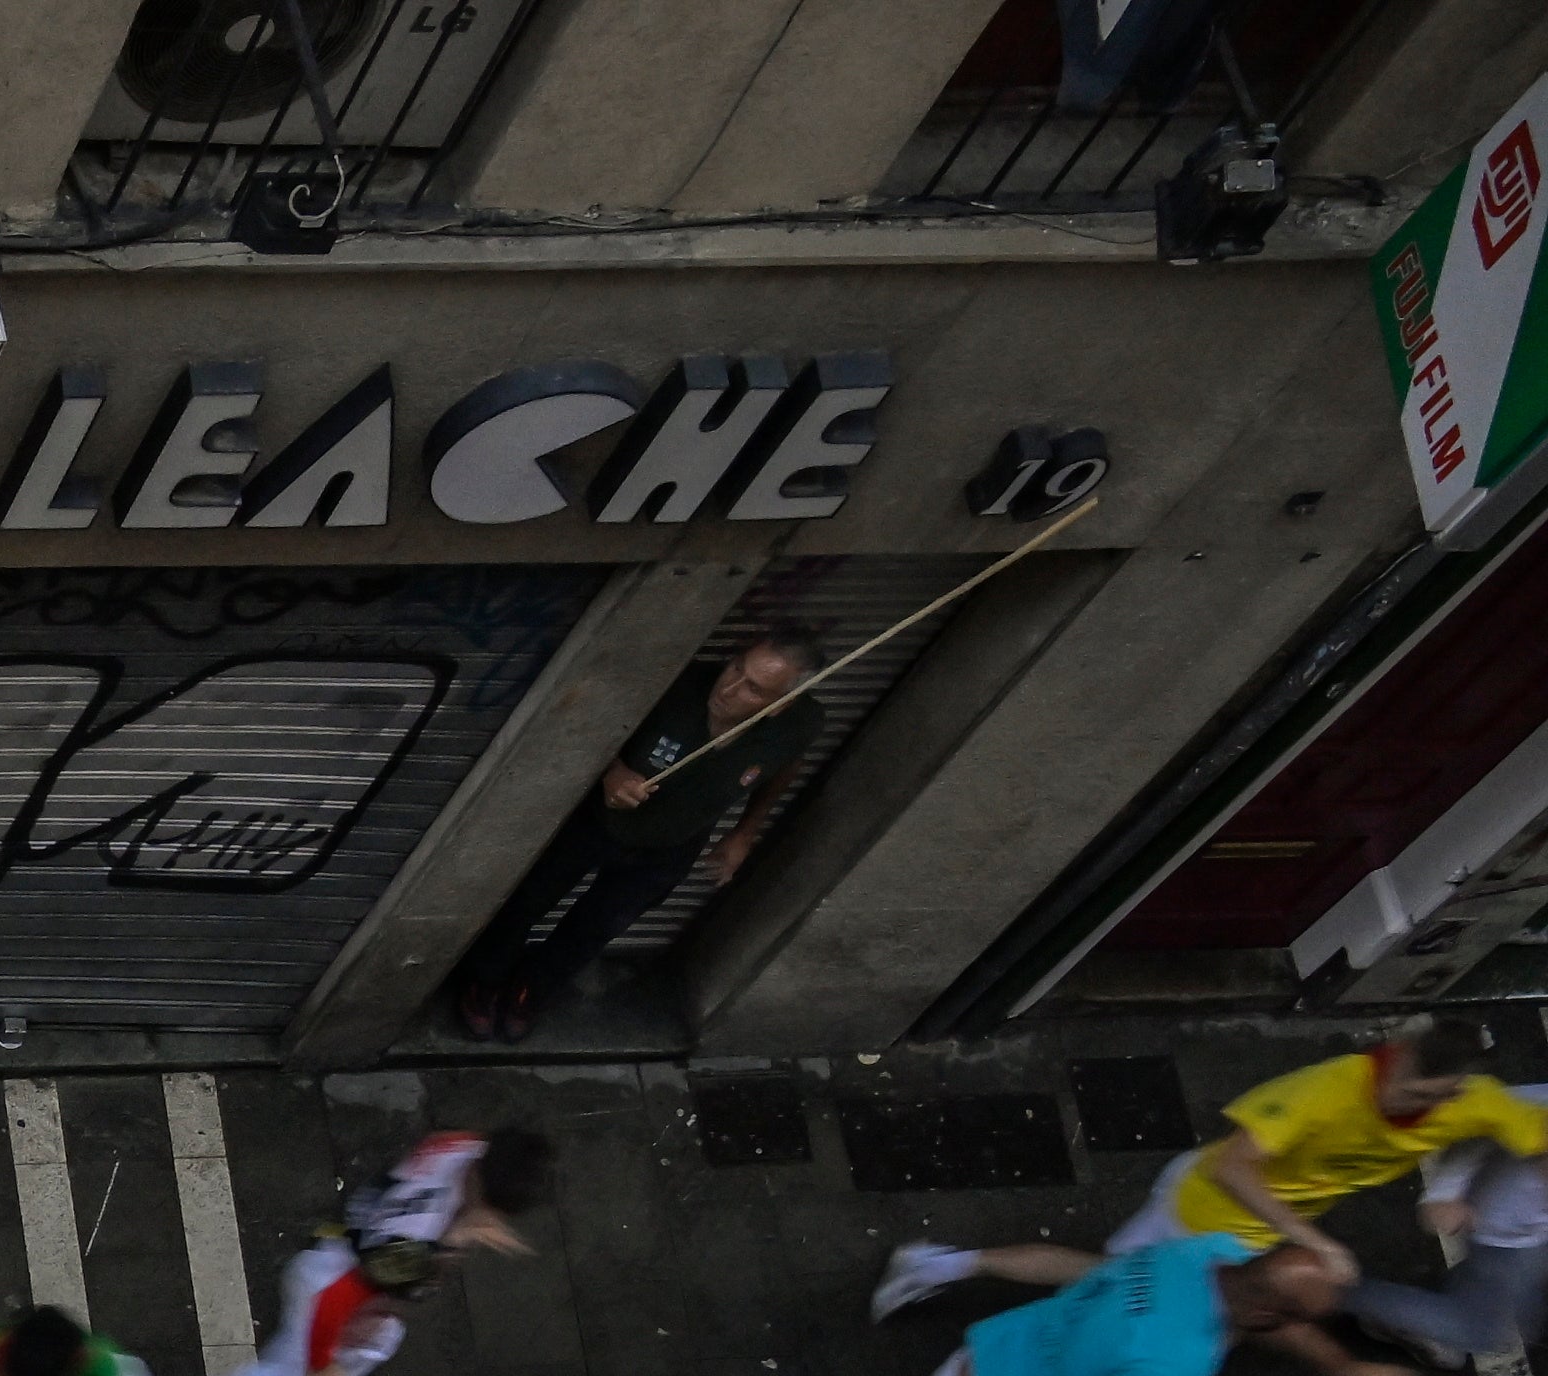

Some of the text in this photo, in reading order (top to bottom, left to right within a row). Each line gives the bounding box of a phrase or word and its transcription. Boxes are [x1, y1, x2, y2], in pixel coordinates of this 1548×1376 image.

[410, 5, 477, 33] LG
[1386, 240, 1466, 485] FUJIFILM
[981, 455, 1108, 515] 19
